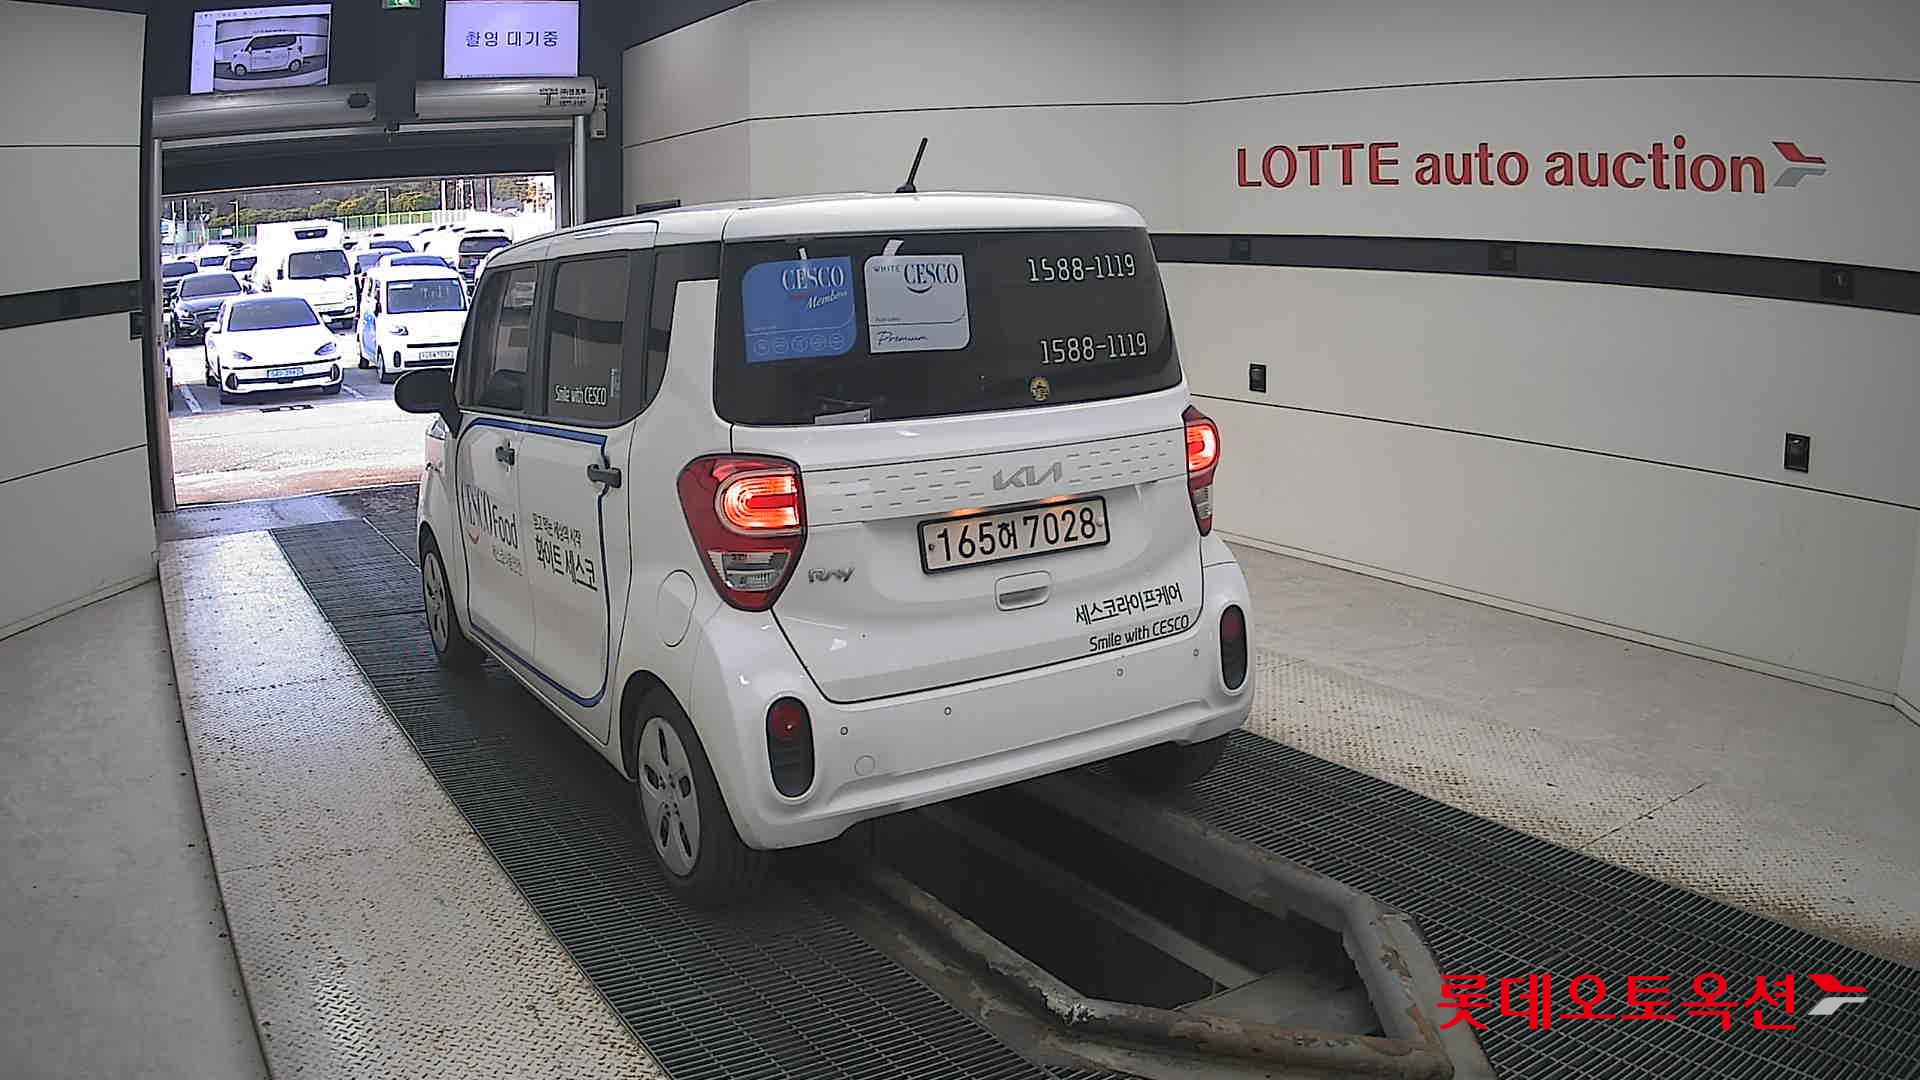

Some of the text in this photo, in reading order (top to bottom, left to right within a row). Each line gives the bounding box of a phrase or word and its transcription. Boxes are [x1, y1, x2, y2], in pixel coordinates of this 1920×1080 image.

[466, 31, 559, 48] 촬영 대기중
[1235, 135, 1766, 193] LOTTE auto auction
[782, 265, 845, 290] CESCO
[904, 263, 959, 285] CESCO
[1027, 253, 1136, 282] 1588-1119
[1040, 331, 1148, 364] 1588-1119
[993, 462, 1062, 491] KIA
[937, 506, 1096, 562] 165허 7028
[1075, 582, 1184, 625] 세스코라이프케어
[1089, 614, 1190, 652] Smile with CESCO
